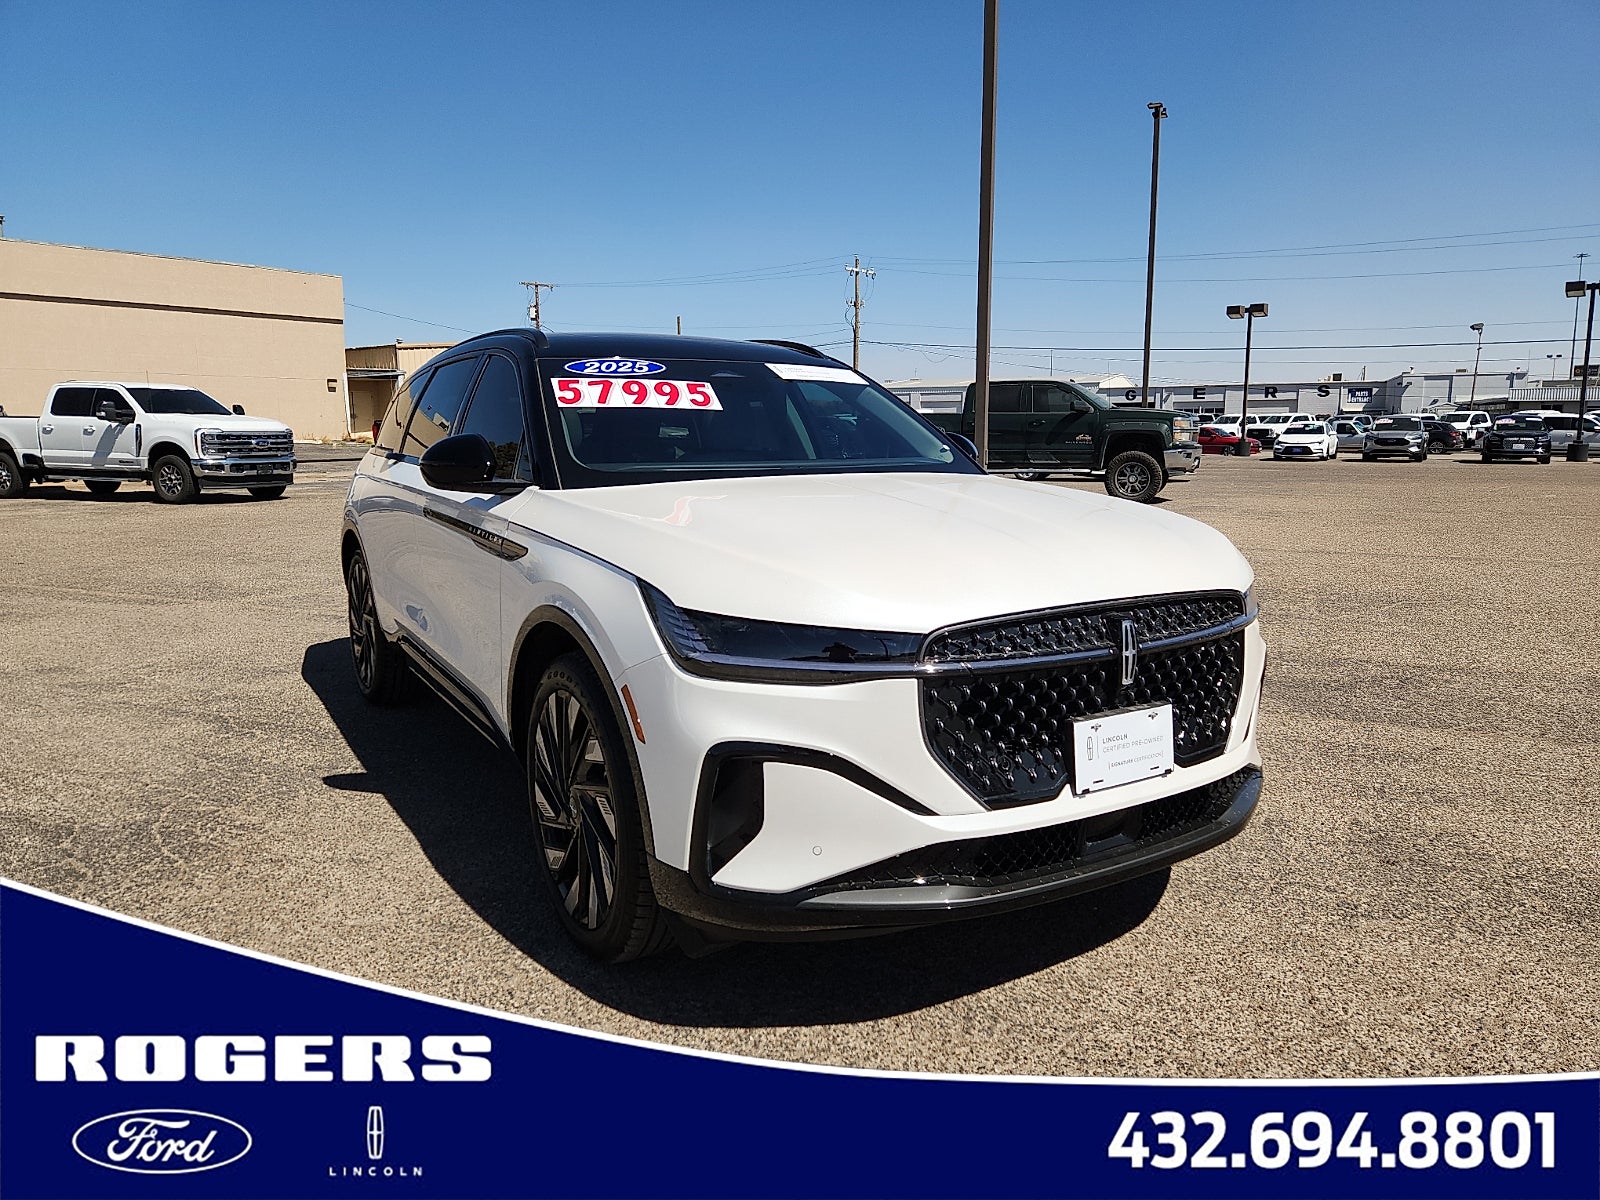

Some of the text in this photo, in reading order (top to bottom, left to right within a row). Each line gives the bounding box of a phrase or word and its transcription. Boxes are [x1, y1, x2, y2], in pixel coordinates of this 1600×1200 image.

[583, 361, 649, 373] 2025
[557, 379, 712, 407] 57995
[1102, 733, 1128, 744] LINCOLN
[1102, 735, 1164, 753] CERTIFIED PRE-OWNED
